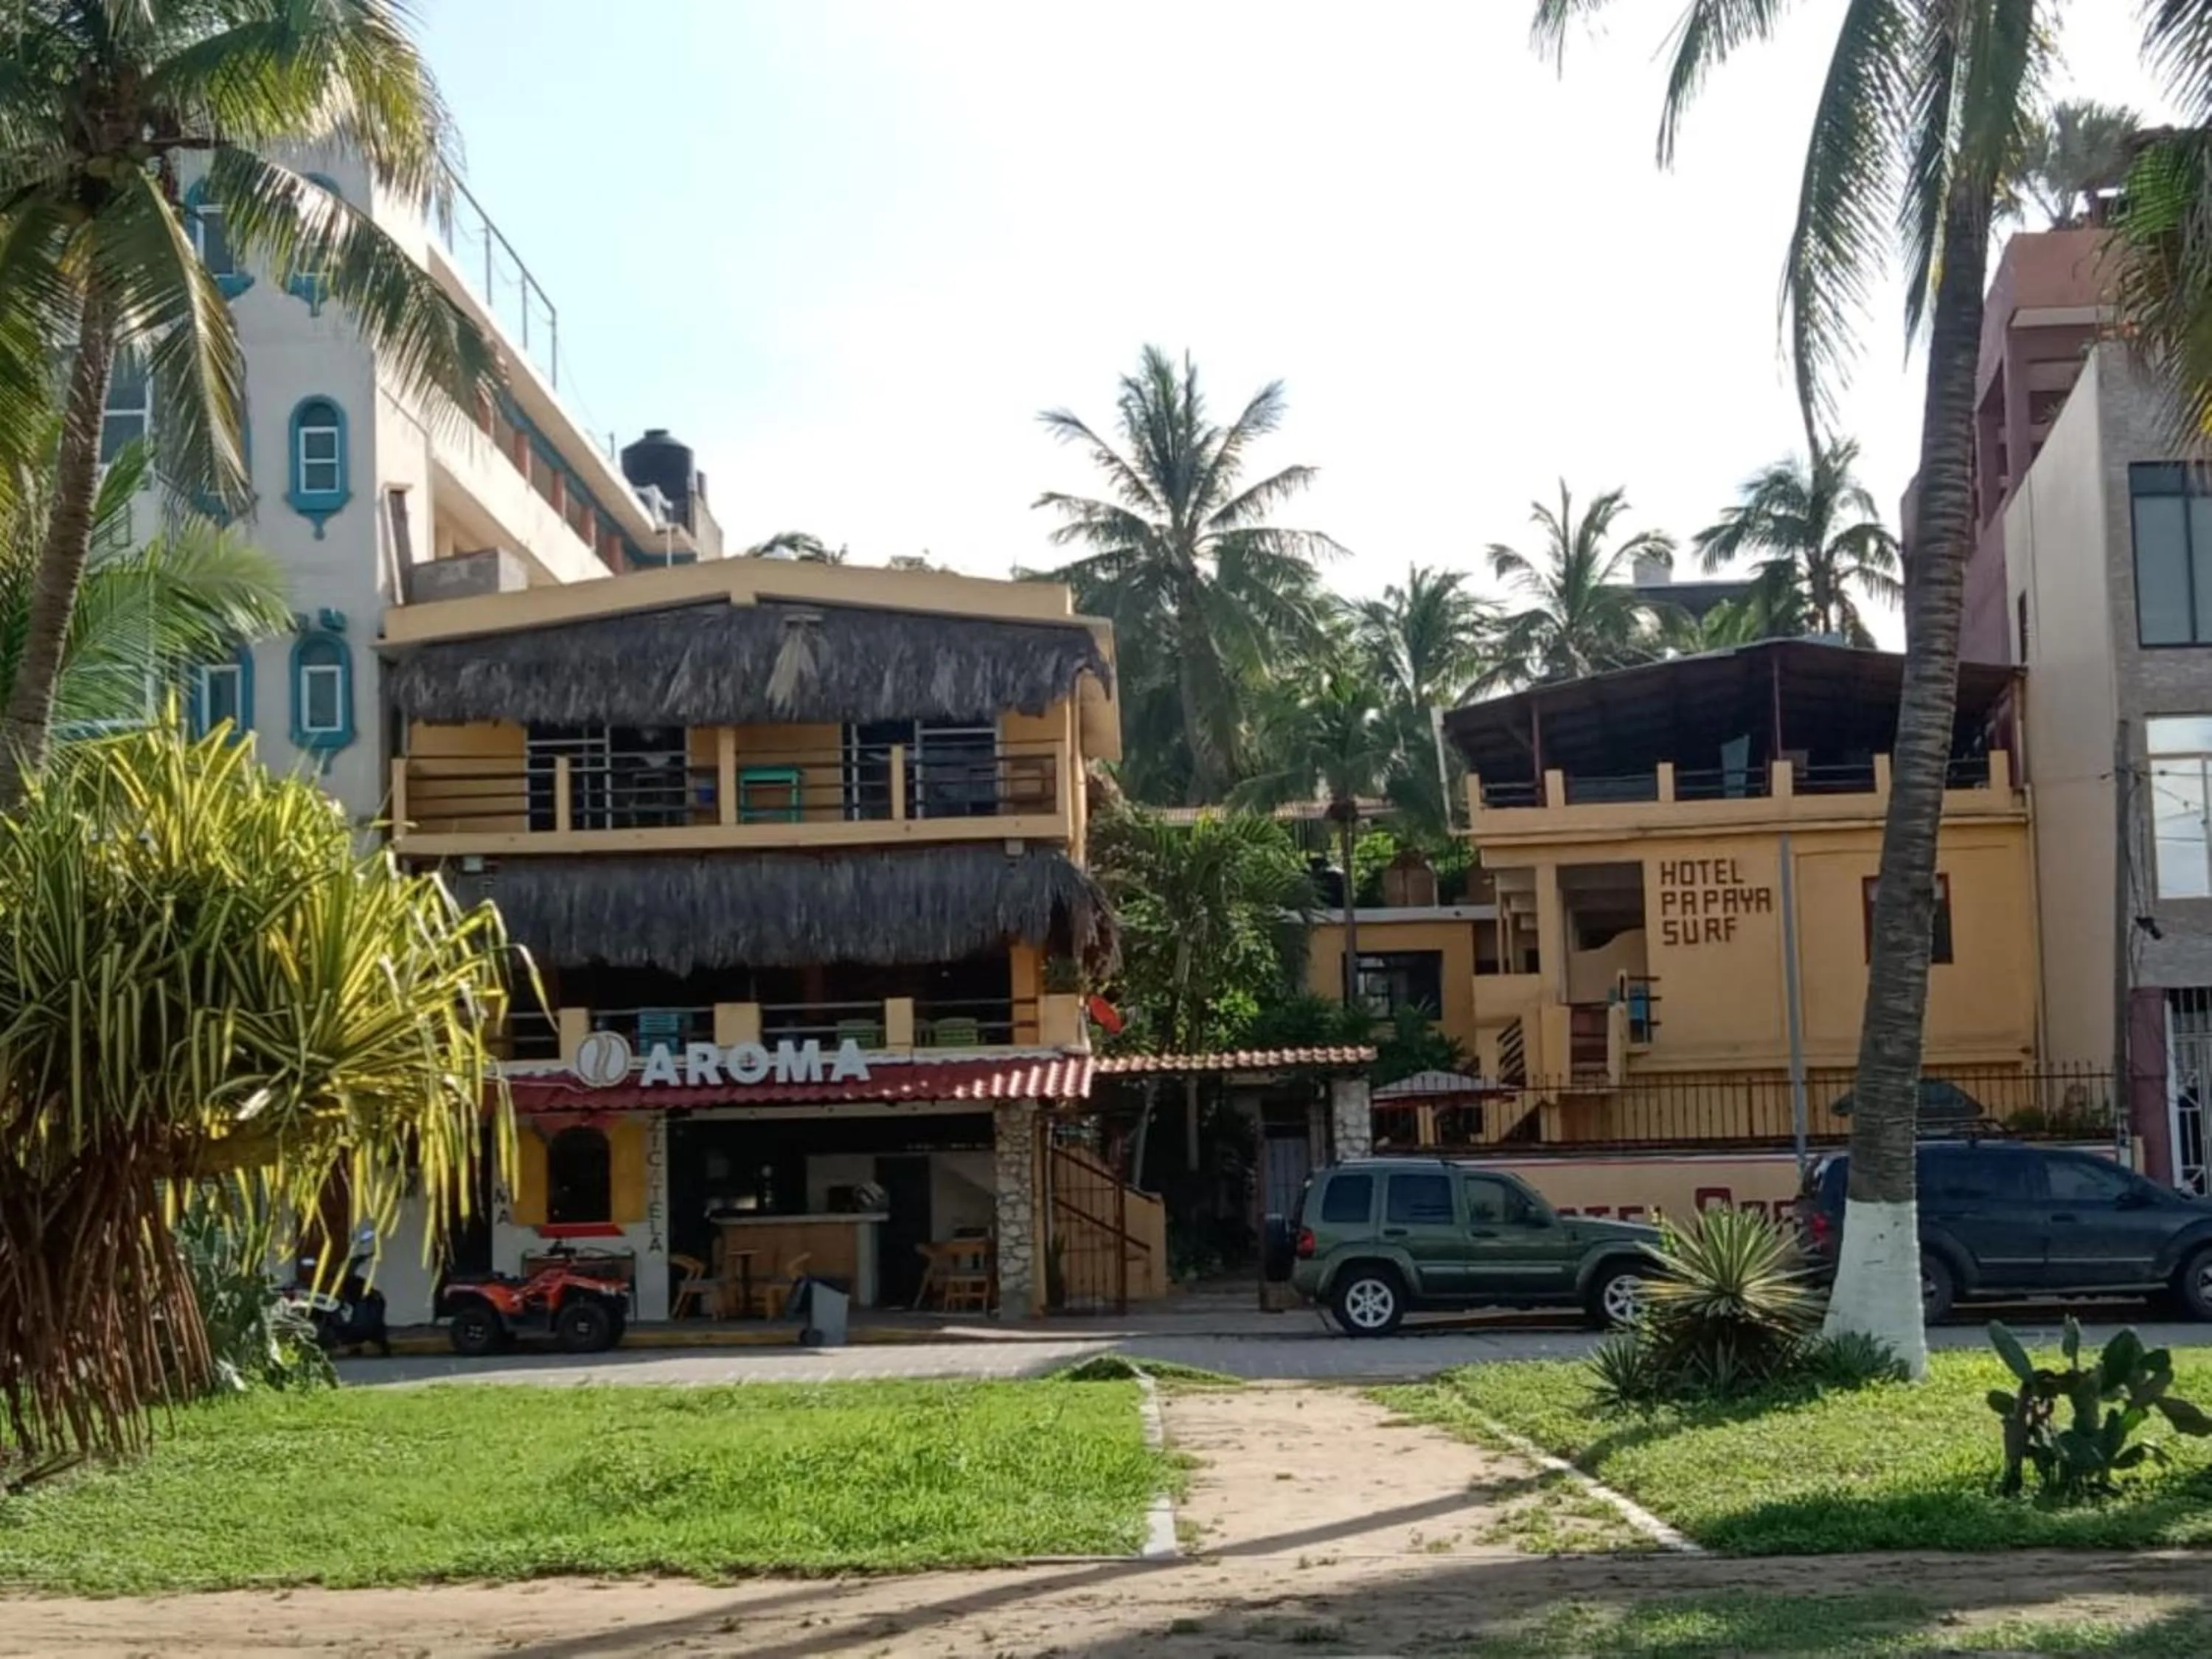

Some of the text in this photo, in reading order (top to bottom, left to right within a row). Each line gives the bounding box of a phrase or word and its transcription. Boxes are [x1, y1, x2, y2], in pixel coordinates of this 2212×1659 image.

[1660, 859, 1745, 886] HOTEL
[1660, 887, 1772, 917] PAPAYA
[1663, 917, 1736, 946] SURF
[639, 1038, 872, 1087] AROMA
